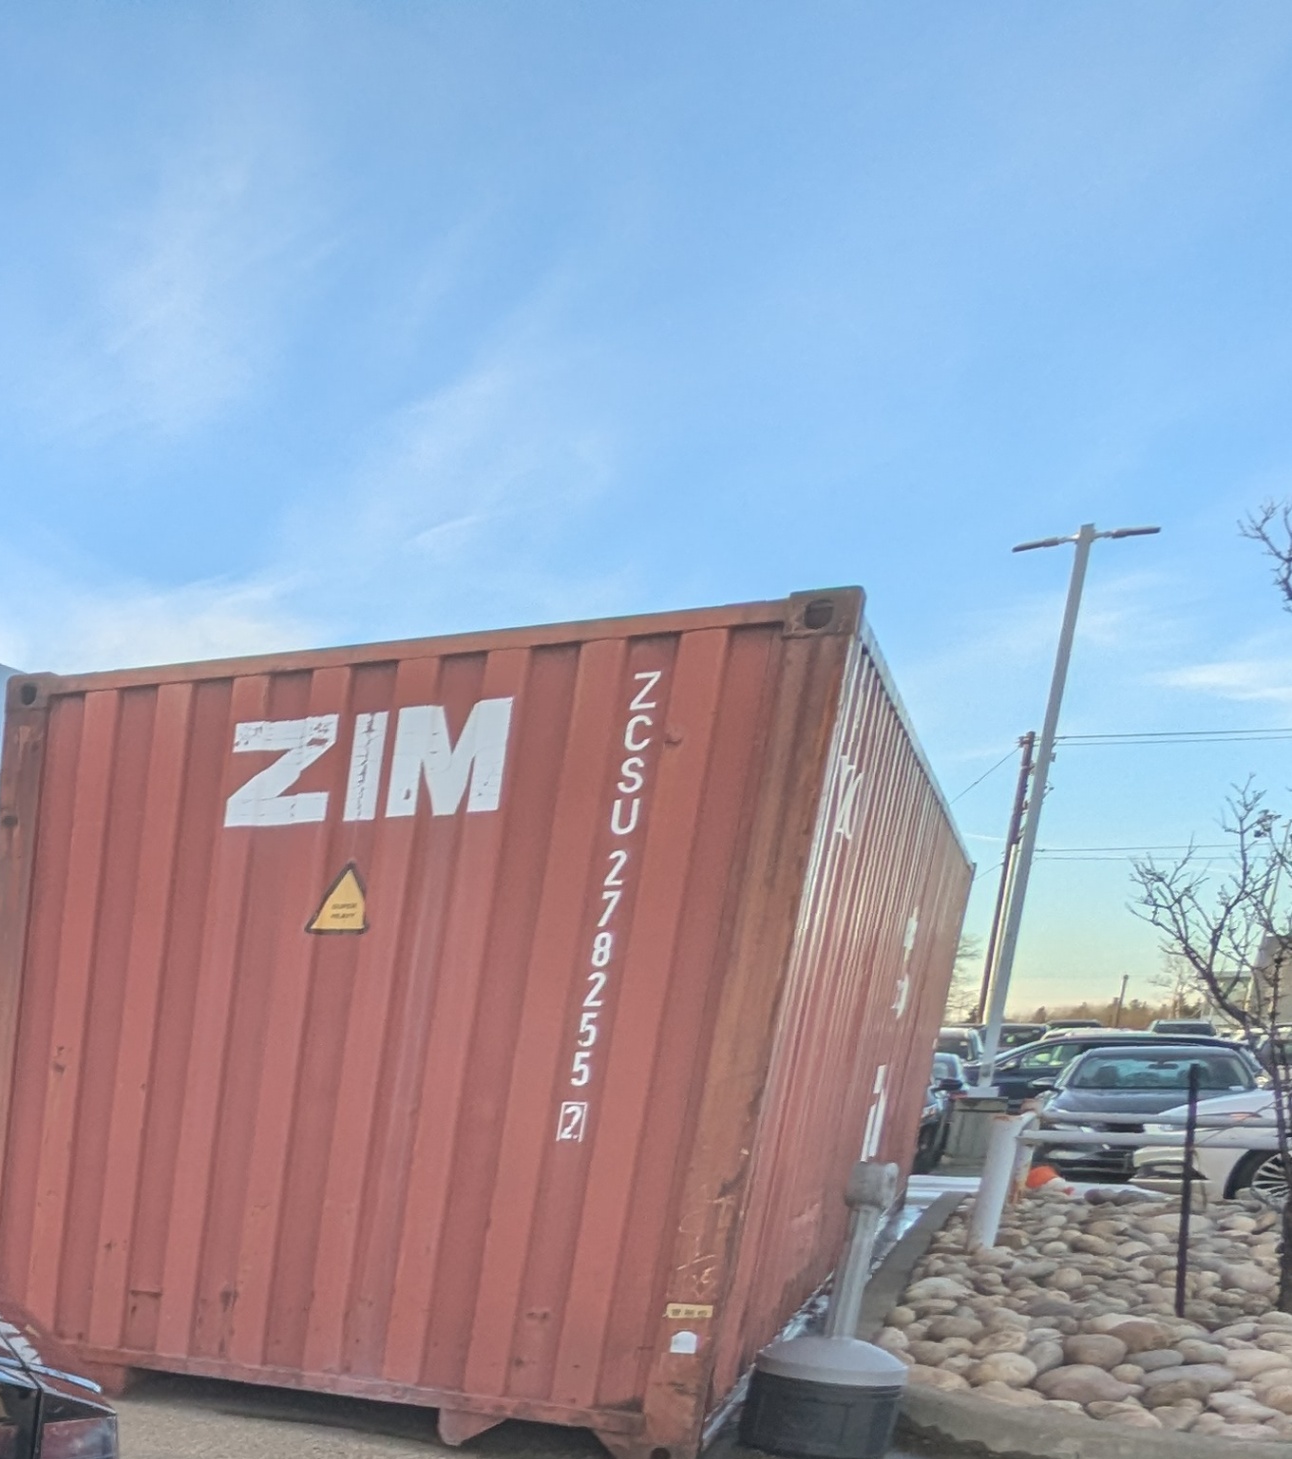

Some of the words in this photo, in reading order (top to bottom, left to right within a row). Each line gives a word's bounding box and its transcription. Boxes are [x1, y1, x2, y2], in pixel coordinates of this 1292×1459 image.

[223, 697, 514, 827] ZIM
[611, 671, 662, 835] ZCSU
[570, 850, 628, 1086] 278255
